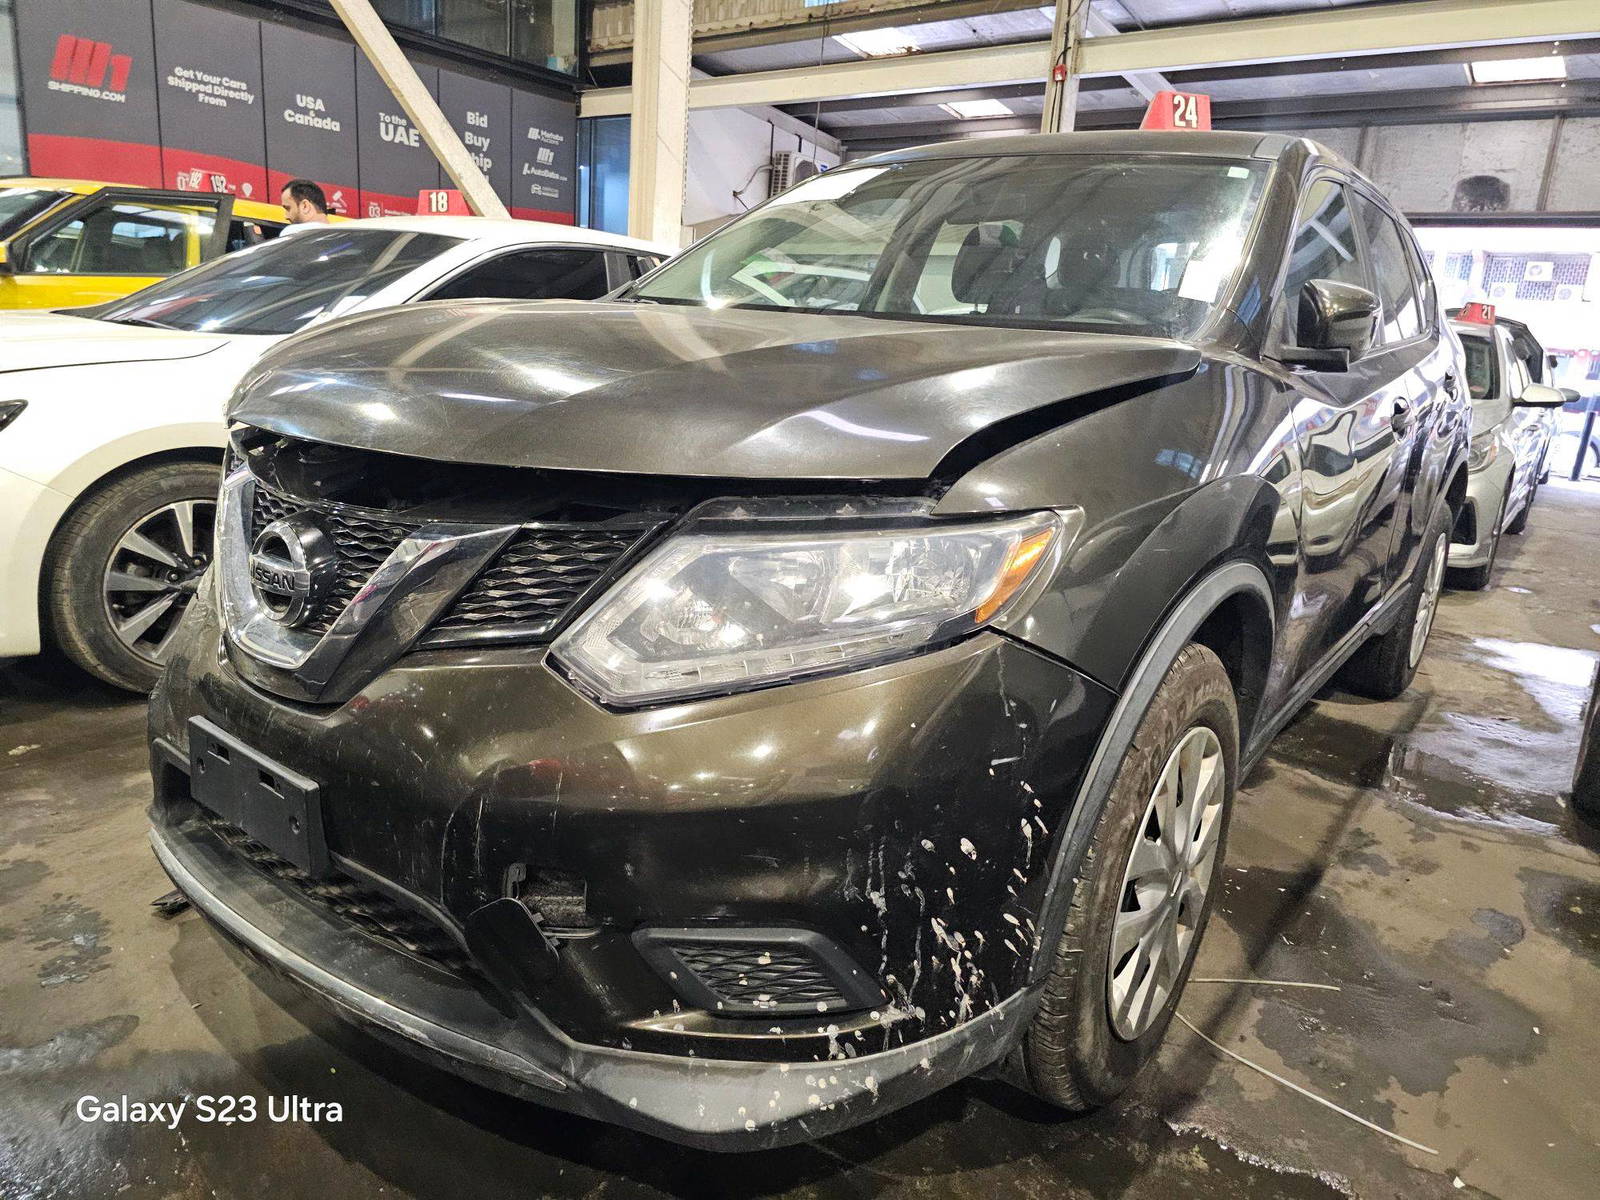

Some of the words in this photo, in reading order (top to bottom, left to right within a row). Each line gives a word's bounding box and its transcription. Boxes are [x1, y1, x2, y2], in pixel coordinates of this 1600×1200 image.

[174, 66, 195, 79] Get
[195, 70, 221, 85] Your
[222, 77, 247, 91] Cars
[167, 75, 213, 93] Shipped
[213, 85, 255, 105] Directly
[198, 92, 227, 107] From
[296, 94, 326, 112] USA
[1173, 94, 1198, 129] 24
[283, 109, 341, 132] Canada
[379, 112, 391, 124] To
[391, 115, 407, 126] the
[466, 111, 488, 128] Bid
[380, 122, 420, 148] UAE
[464, 131, 490, 152] Buy
[471, 152, 492, 172] hip
[429, 191, 449, 213] 18
[1481, 304, 1492, 320] 21
